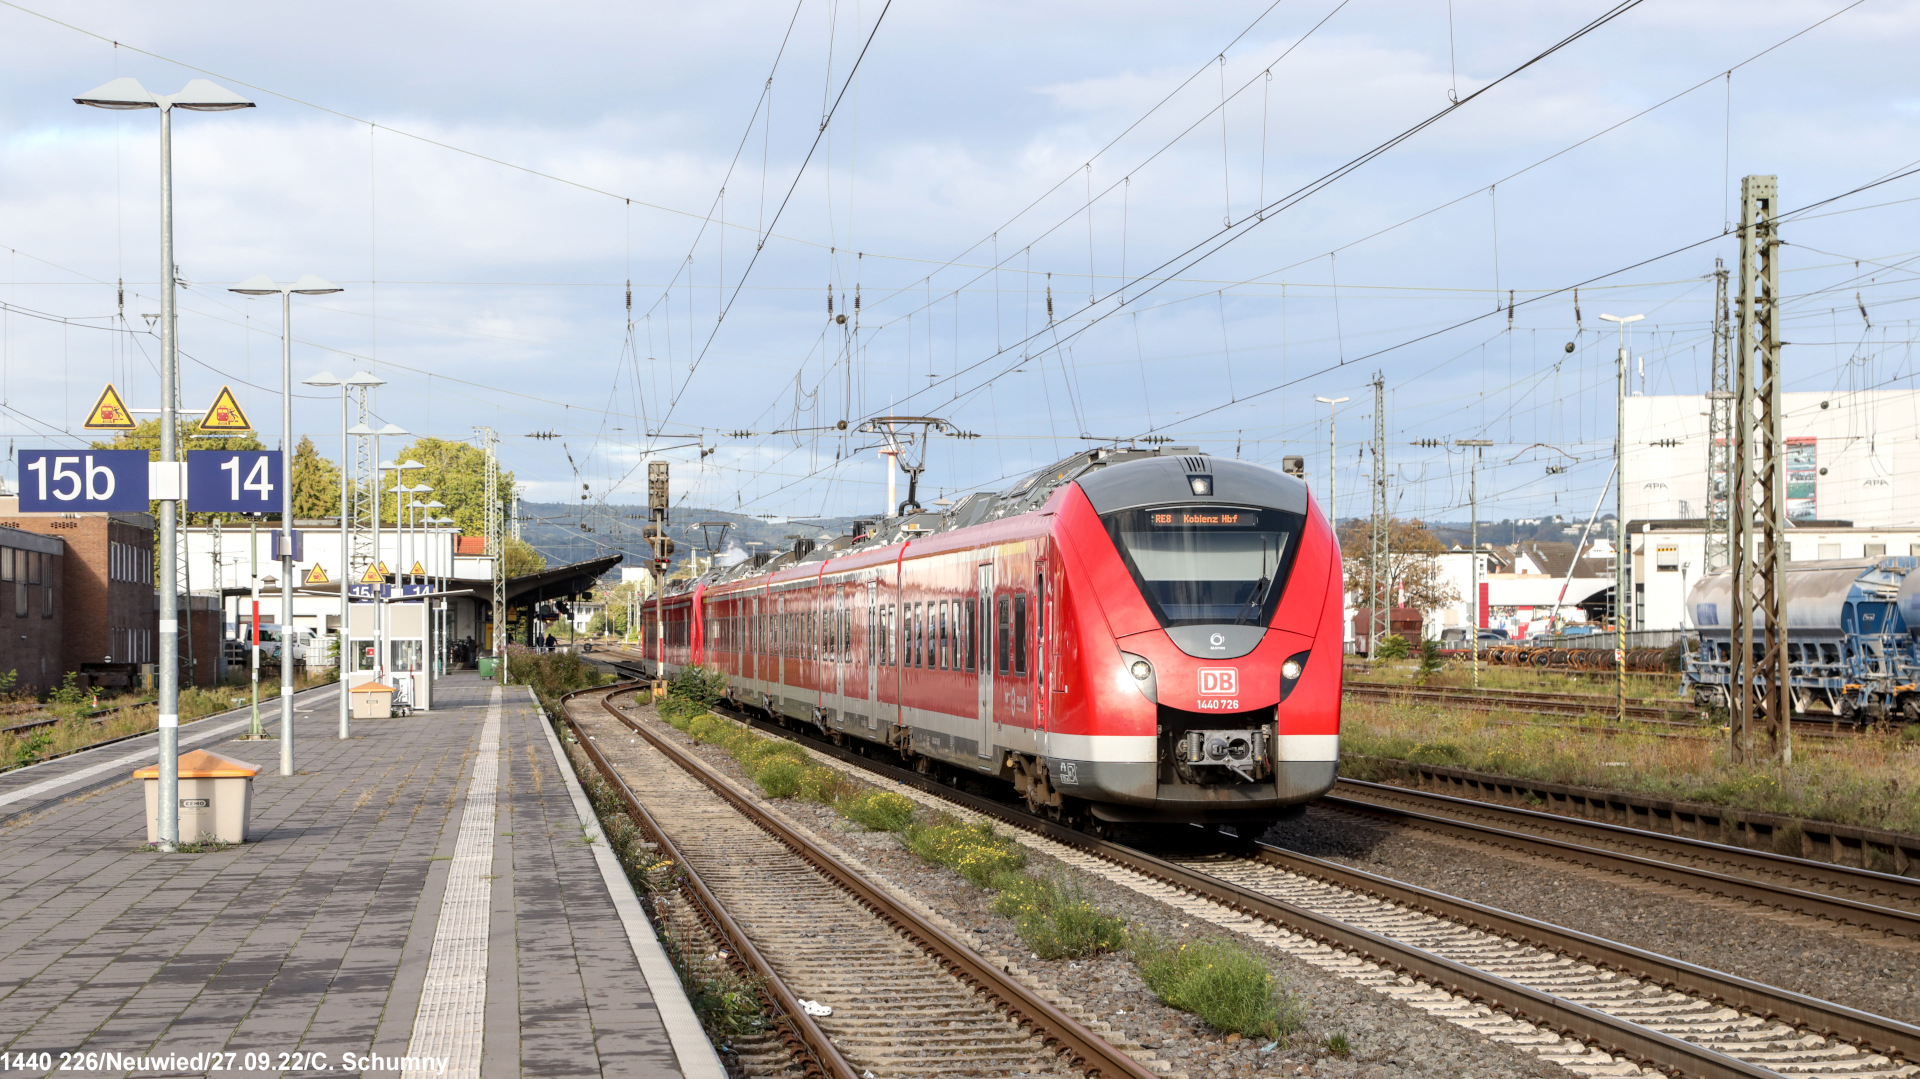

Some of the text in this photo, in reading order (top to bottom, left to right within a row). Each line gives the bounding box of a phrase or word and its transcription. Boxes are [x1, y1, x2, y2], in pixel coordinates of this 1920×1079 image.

[27, 455, 116, 501] 15b
[220, 455, 274, 501] 14
[1155, 514, 1238, 524] RE8 Koblenz Hbf
[1203, 672, 1234, 691] DB
[1197, 700, 1239, 709] 1440 726
